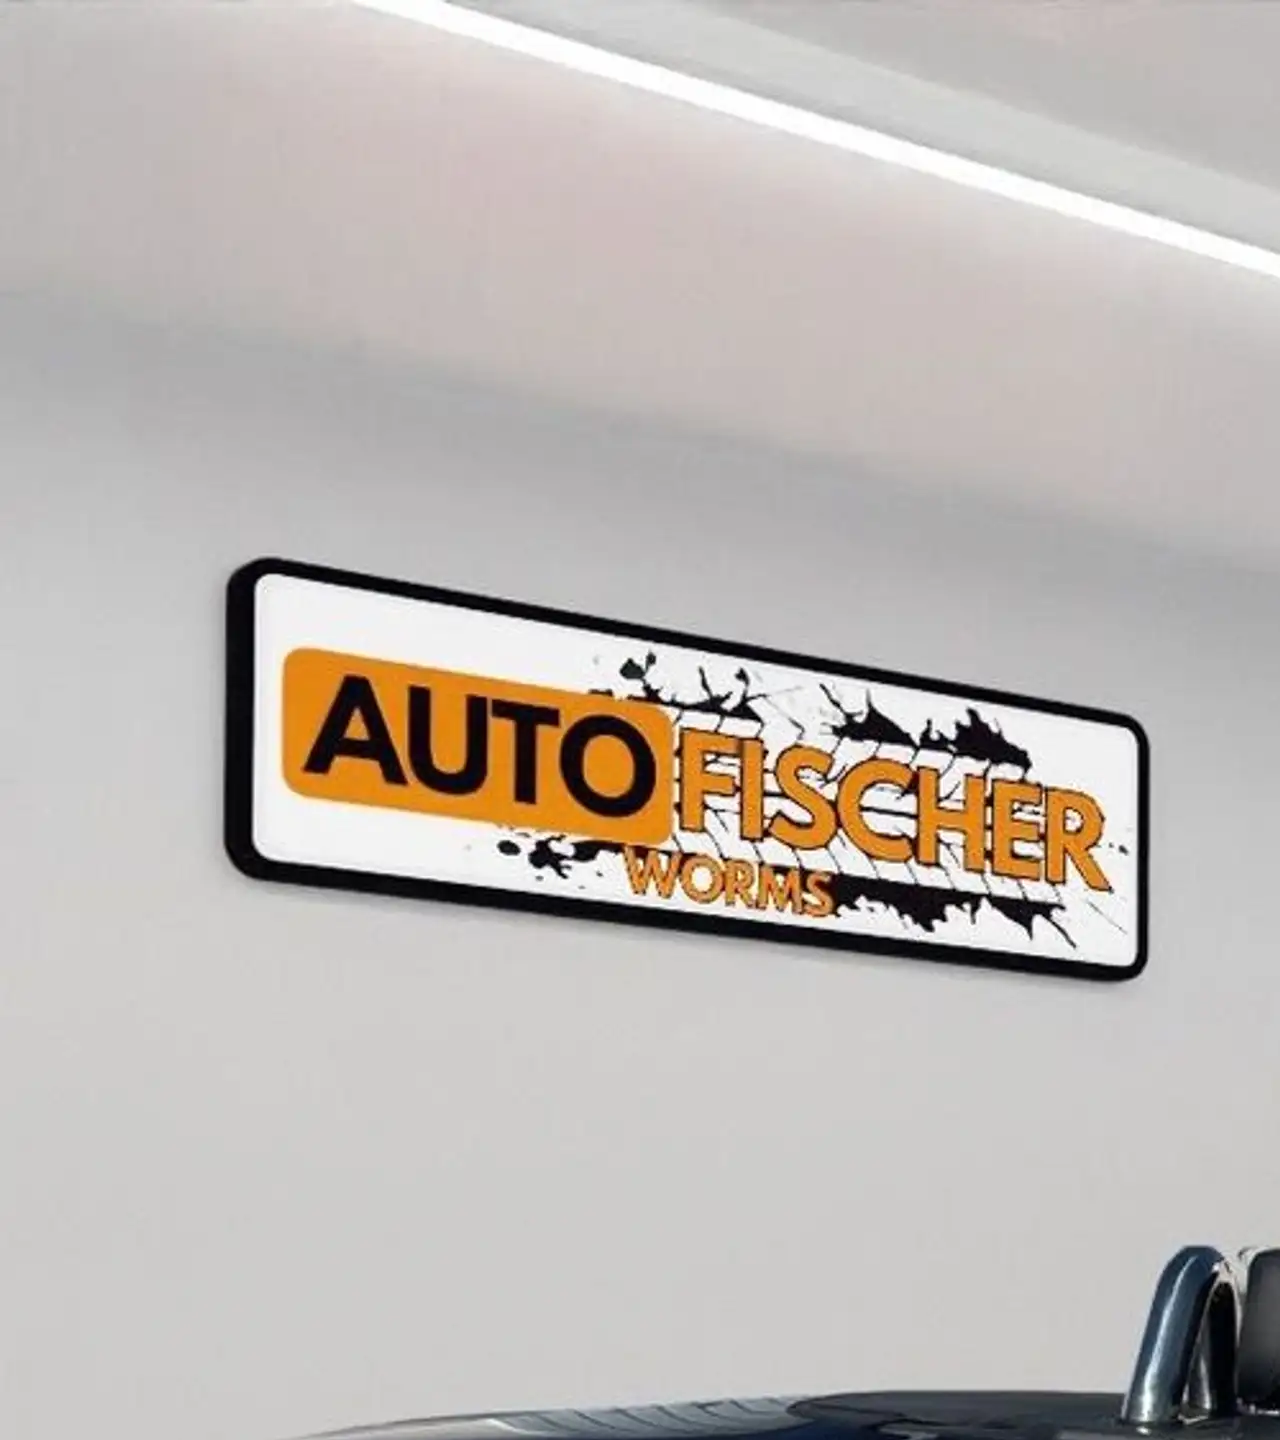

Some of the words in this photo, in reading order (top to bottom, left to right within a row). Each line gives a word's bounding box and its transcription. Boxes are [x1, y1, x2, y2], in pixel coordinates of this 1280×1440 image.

[302, 675, 658, 818] AUTO
[676, 726, 1112, 893] FISCHER
[620, 846, 835, 918] WORMS
